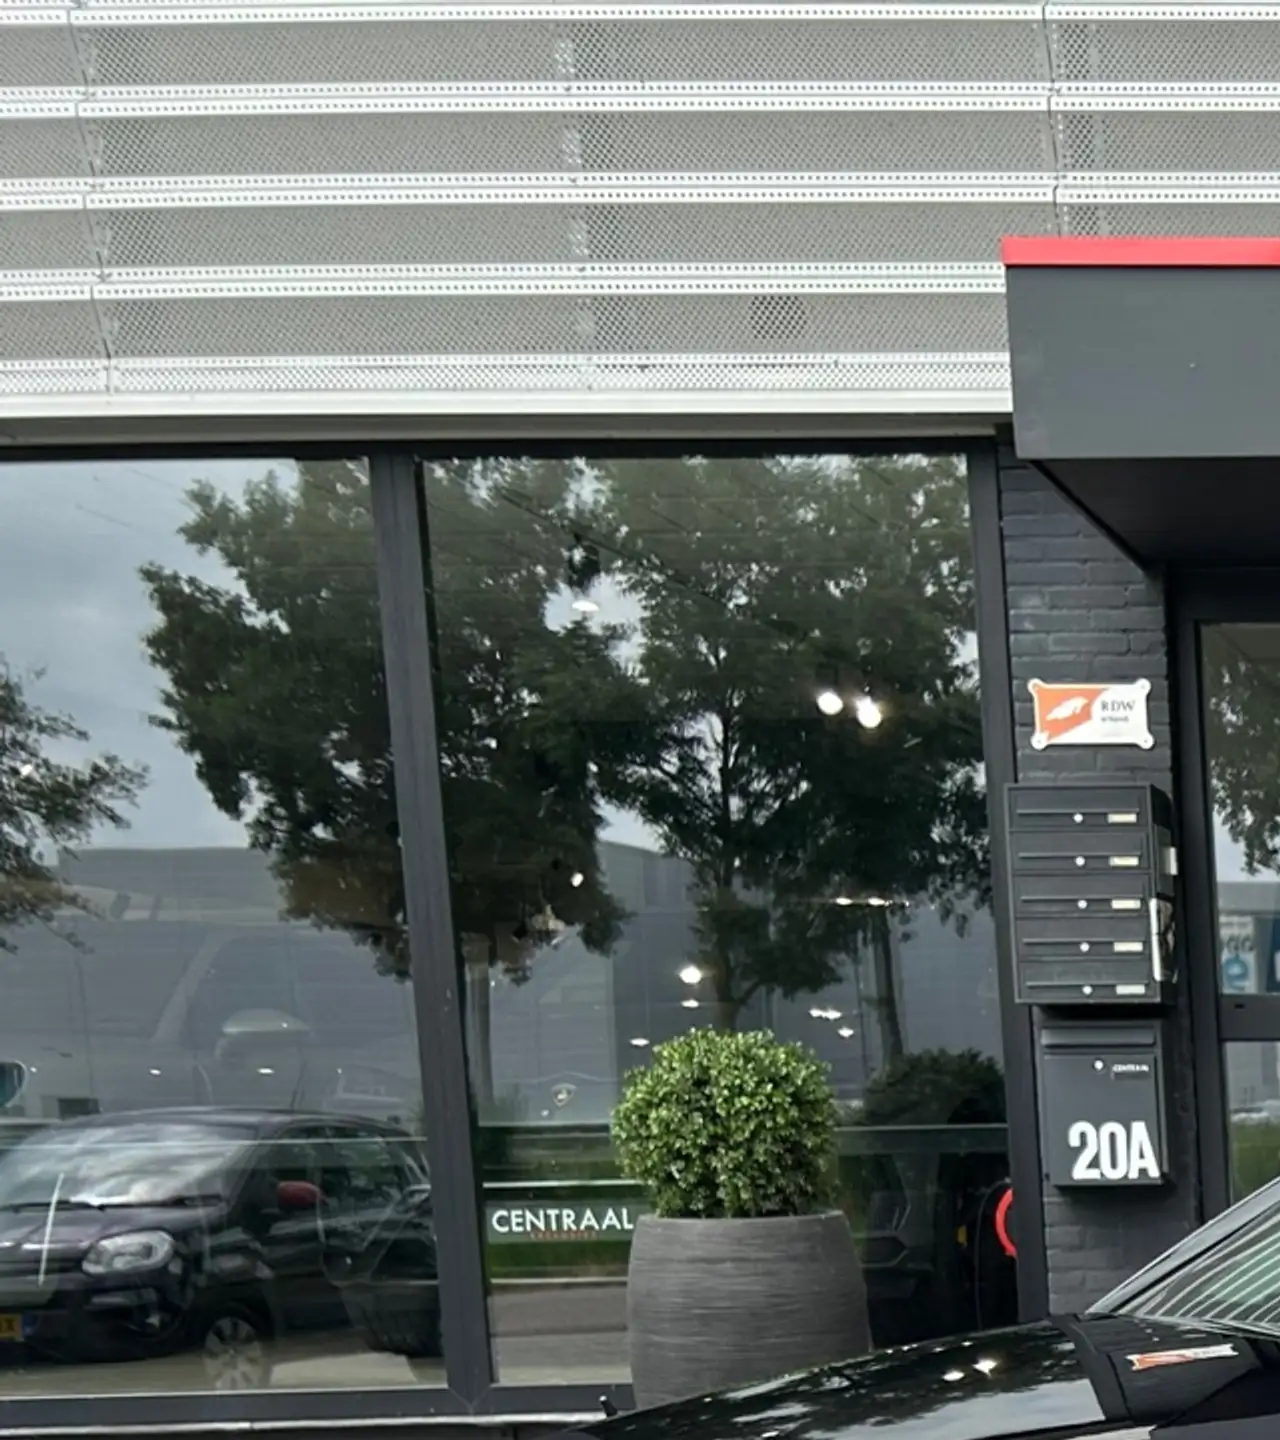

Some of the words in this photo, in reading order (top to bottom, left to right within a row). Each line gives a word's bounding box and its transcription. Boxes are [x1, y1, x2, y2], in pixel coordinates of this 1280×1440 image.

[1101, 699, 1136, 712] RDW
[1067, 1120, 1161, 1181] 20A
[491, 1207, 634, 1233] CENTRAAL
